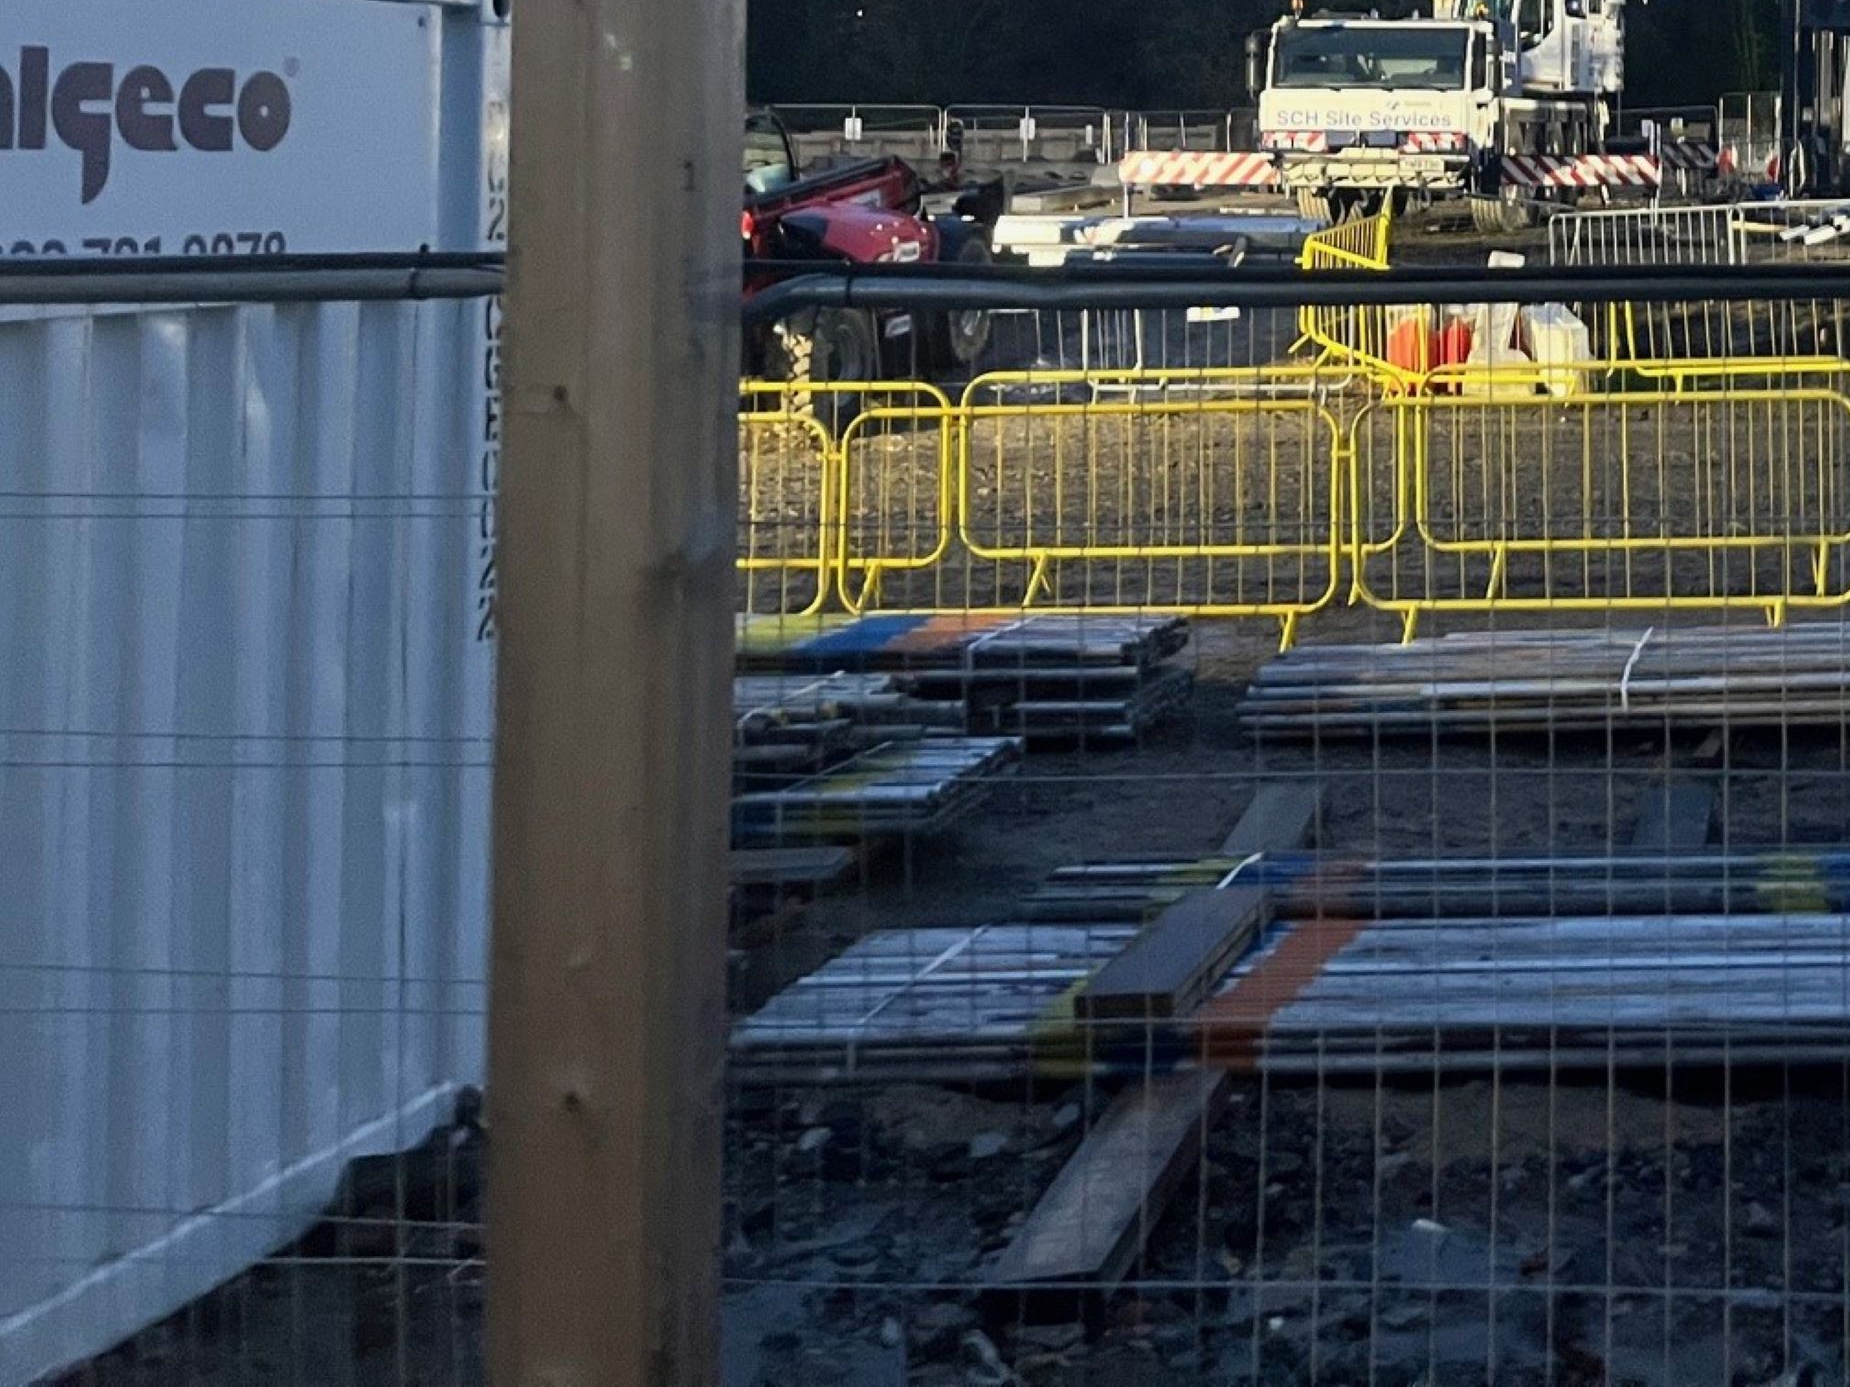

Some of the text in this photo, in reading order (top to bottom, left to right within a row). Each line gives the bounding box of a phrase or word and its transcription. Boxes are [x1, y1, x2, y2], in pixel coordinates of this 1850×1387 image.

[0, 45, 292, 205] lgeco
[1276, 110, 1453, 127] SCH Site Services
